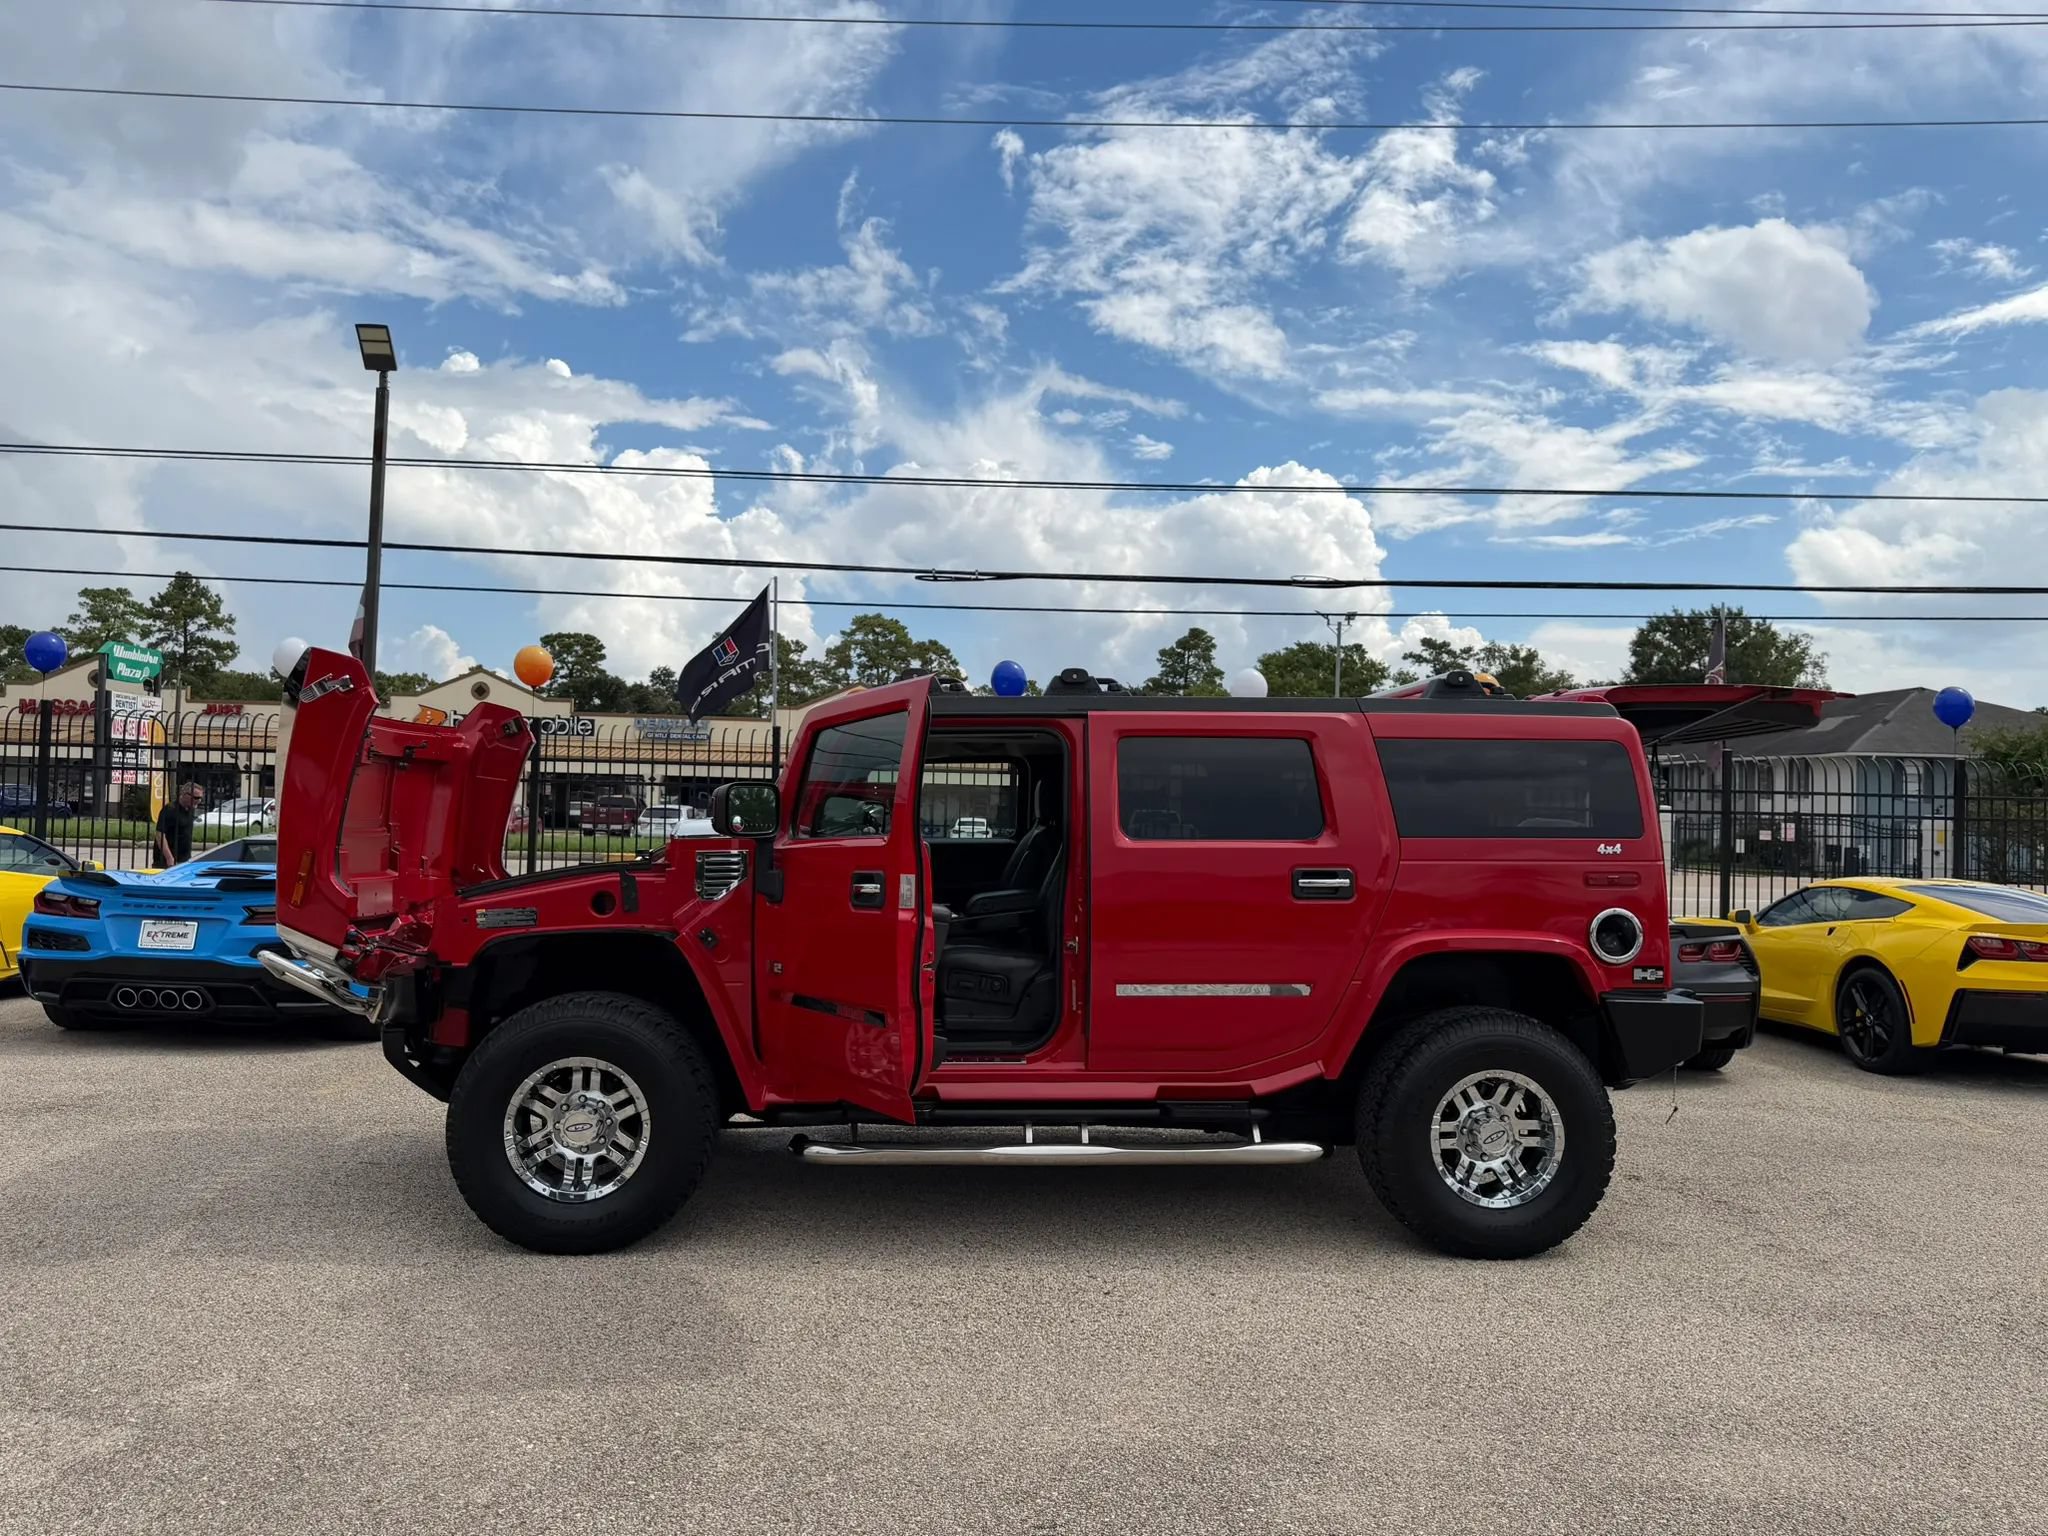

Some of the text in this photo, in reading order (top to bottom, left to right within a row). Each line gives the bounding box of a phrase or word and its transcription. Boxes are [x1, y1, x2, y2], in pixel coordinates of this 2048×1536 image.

[113, 645, 159, 664] Wimbledon
[117, 662, 142, 679] Plaza
[1597, 843, 1622, 855] 4x4
[146, 930, 190, 941] EXTREME
